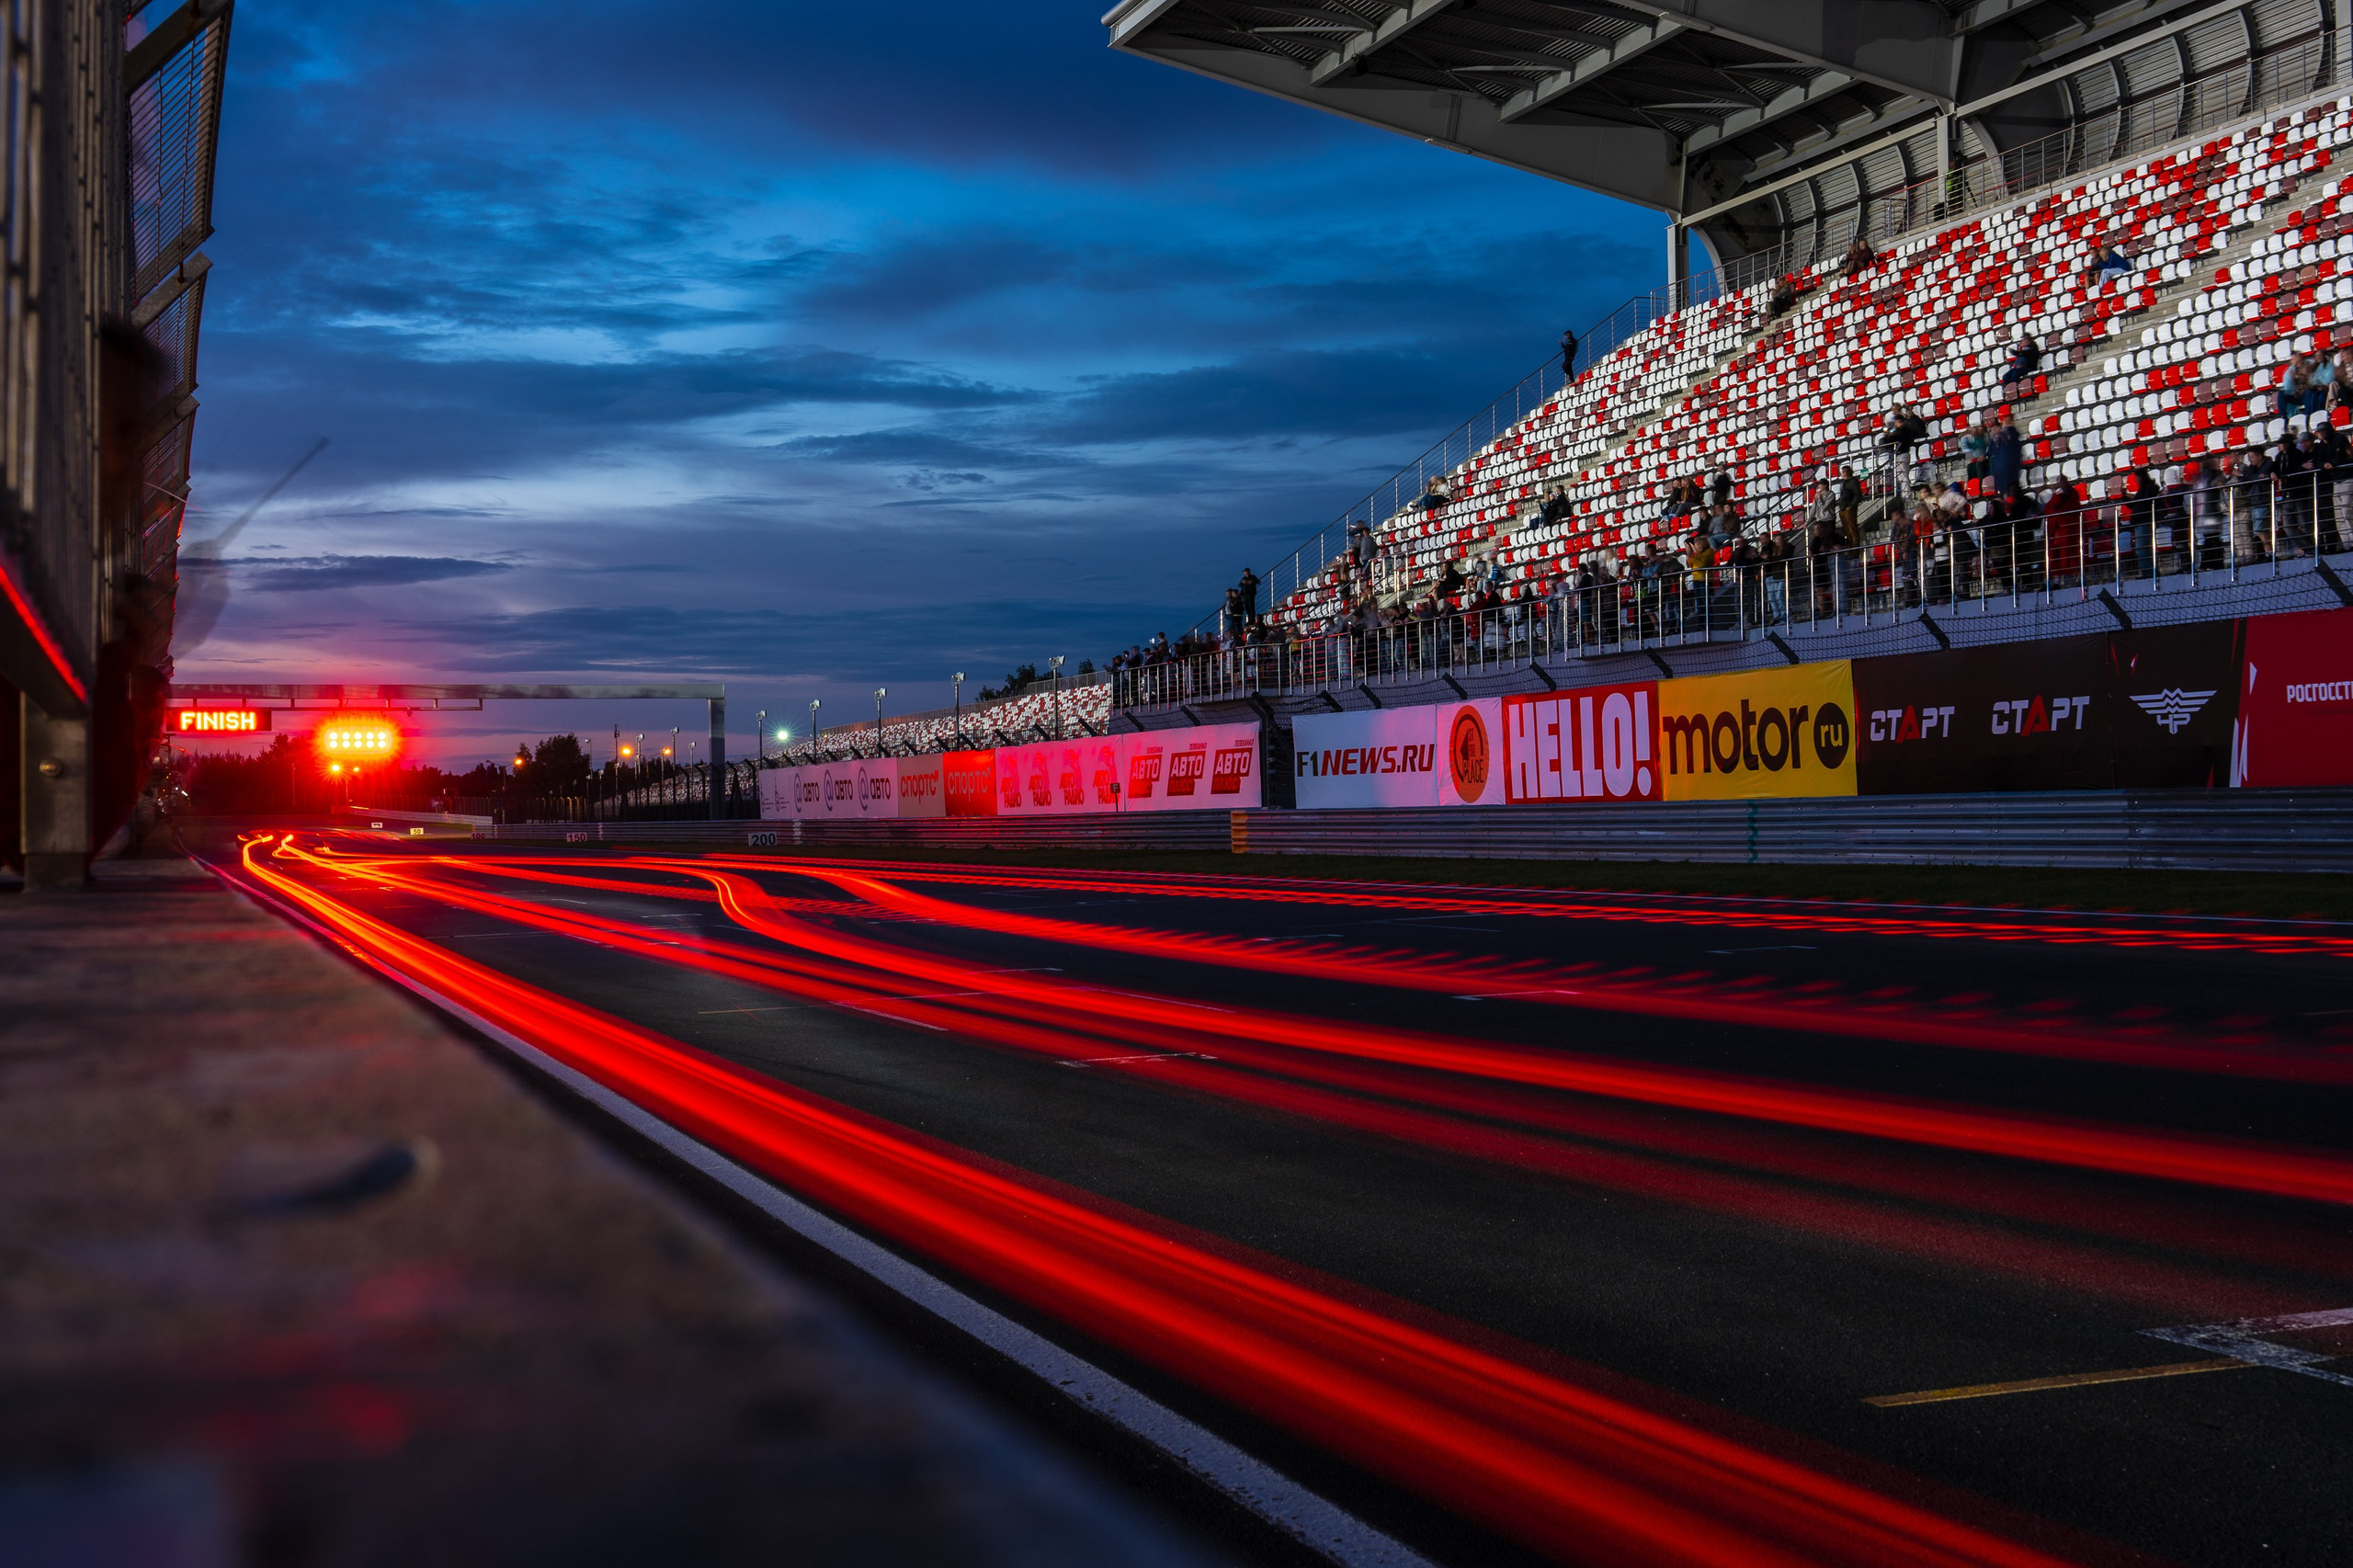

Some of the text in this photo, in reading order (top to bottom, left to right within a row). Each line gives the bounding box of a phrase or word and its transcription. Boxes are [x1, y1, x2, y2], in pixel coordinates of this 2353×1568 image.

[2286, 680, 2353, 703] РОСГОССТ
[180, 710, 256, 732] FINISH
[1870, 704, 1955, 744] СТАРТ
[1991, 695, 2090, 737] СТАРТ
[1508, 690, 1652, 800] HELLO!
[1662, 699, 1843, 775] motor ru
[1131, 758, 1160, 779] АВТО
[1170, 755, 1203, 778] АВТО
[1215, 752, 1250, 775] АВТО
[1296, 744, 1435, 778] F1NEWS.RU
[1112, 783, 1119, 791] F
[1169, 778, 1193, 793] ПЛЮС
[1212, 777, 1238, 791] ПЛЮС
[568, 833, 585, 842] 150
[751, 834, 776, 846] 200
